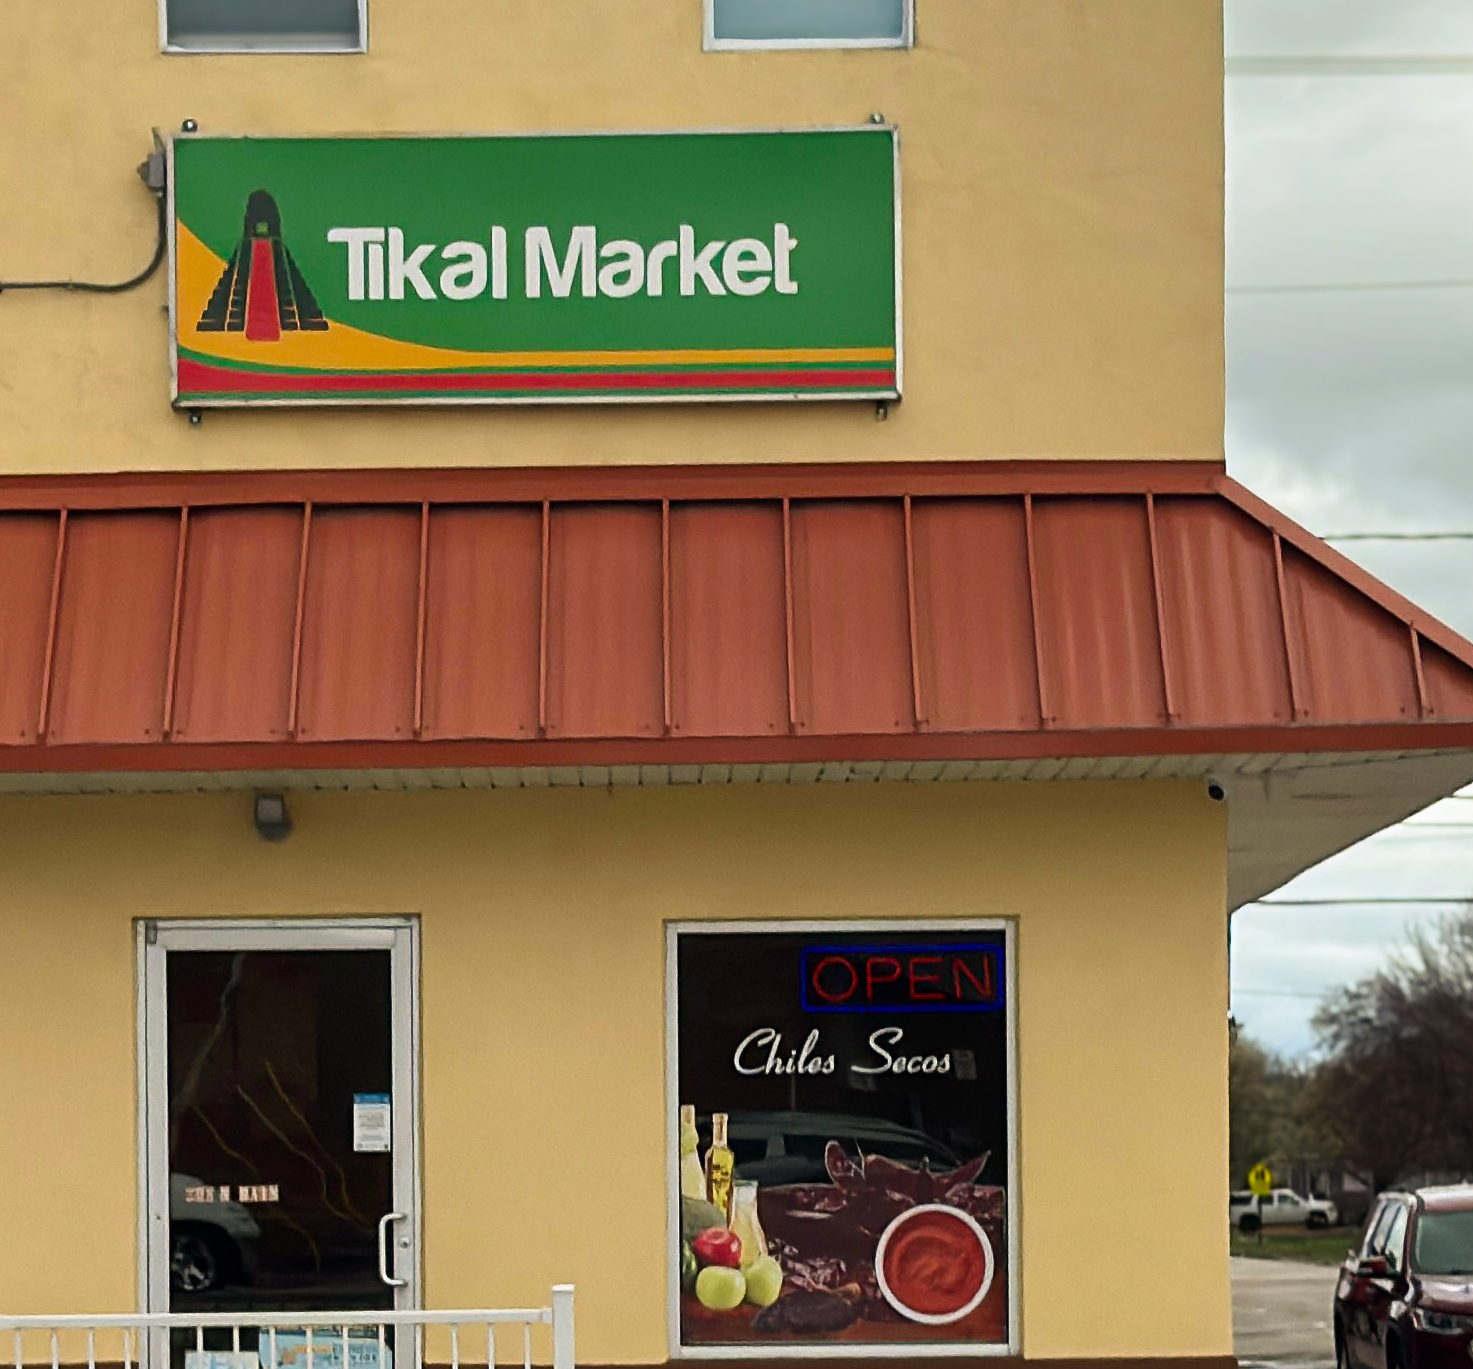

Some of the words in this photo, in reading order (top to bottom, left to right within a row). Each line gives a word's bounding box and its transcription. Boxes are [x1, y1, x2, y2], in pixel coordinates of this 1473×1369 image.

[328, 225, 508, 301] Tikal
[527, 223, 798, 299] Market
[812, 956, 993, 1003] OPEN
[733, 1028, 836, 1076] Chiles
[851, 1027, 952, 1075] Secos
